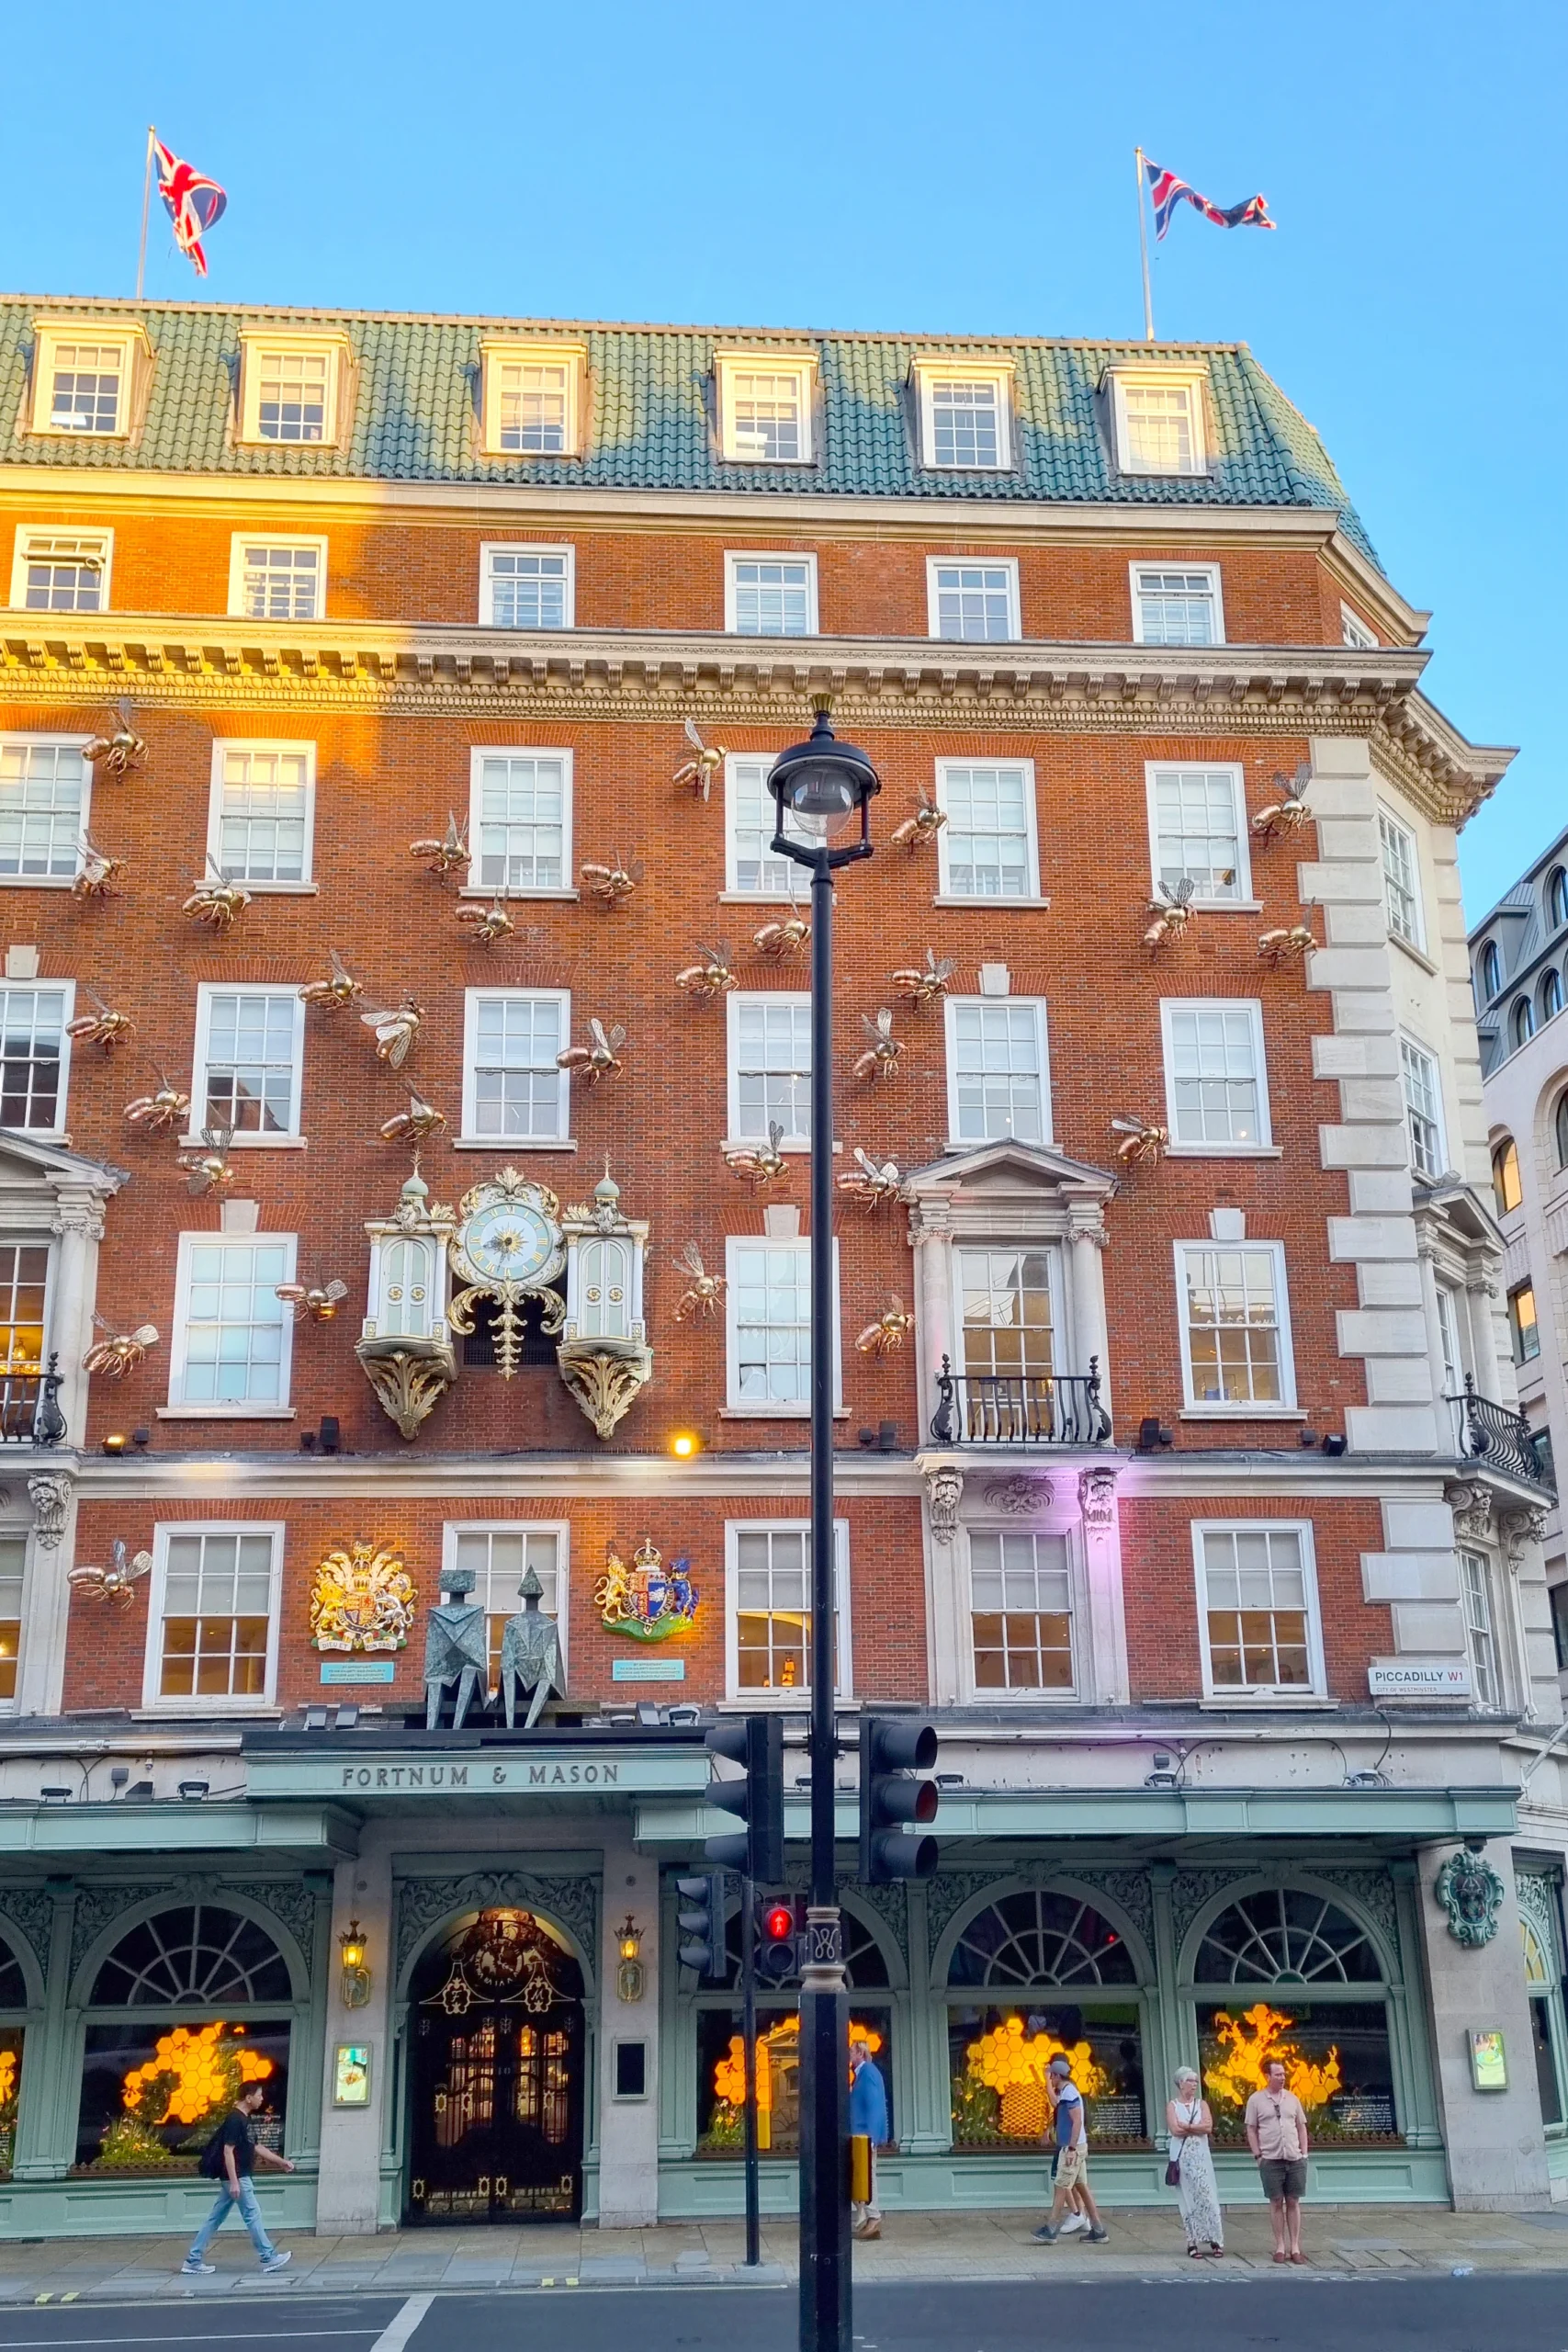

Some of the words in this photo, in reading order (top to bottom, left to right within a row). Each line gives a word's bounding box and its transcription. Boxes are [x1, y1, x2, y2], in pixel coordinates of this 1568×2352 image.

[1375, 1671, 1444, 1682] PICCADILLY
[1448, 1671, 1463, 1681] W1
[342, 1767, 468, 1787] FORTNUM
[492, 1767, 507, 1784] &
[529, 1764, 620, 1783] MASON
